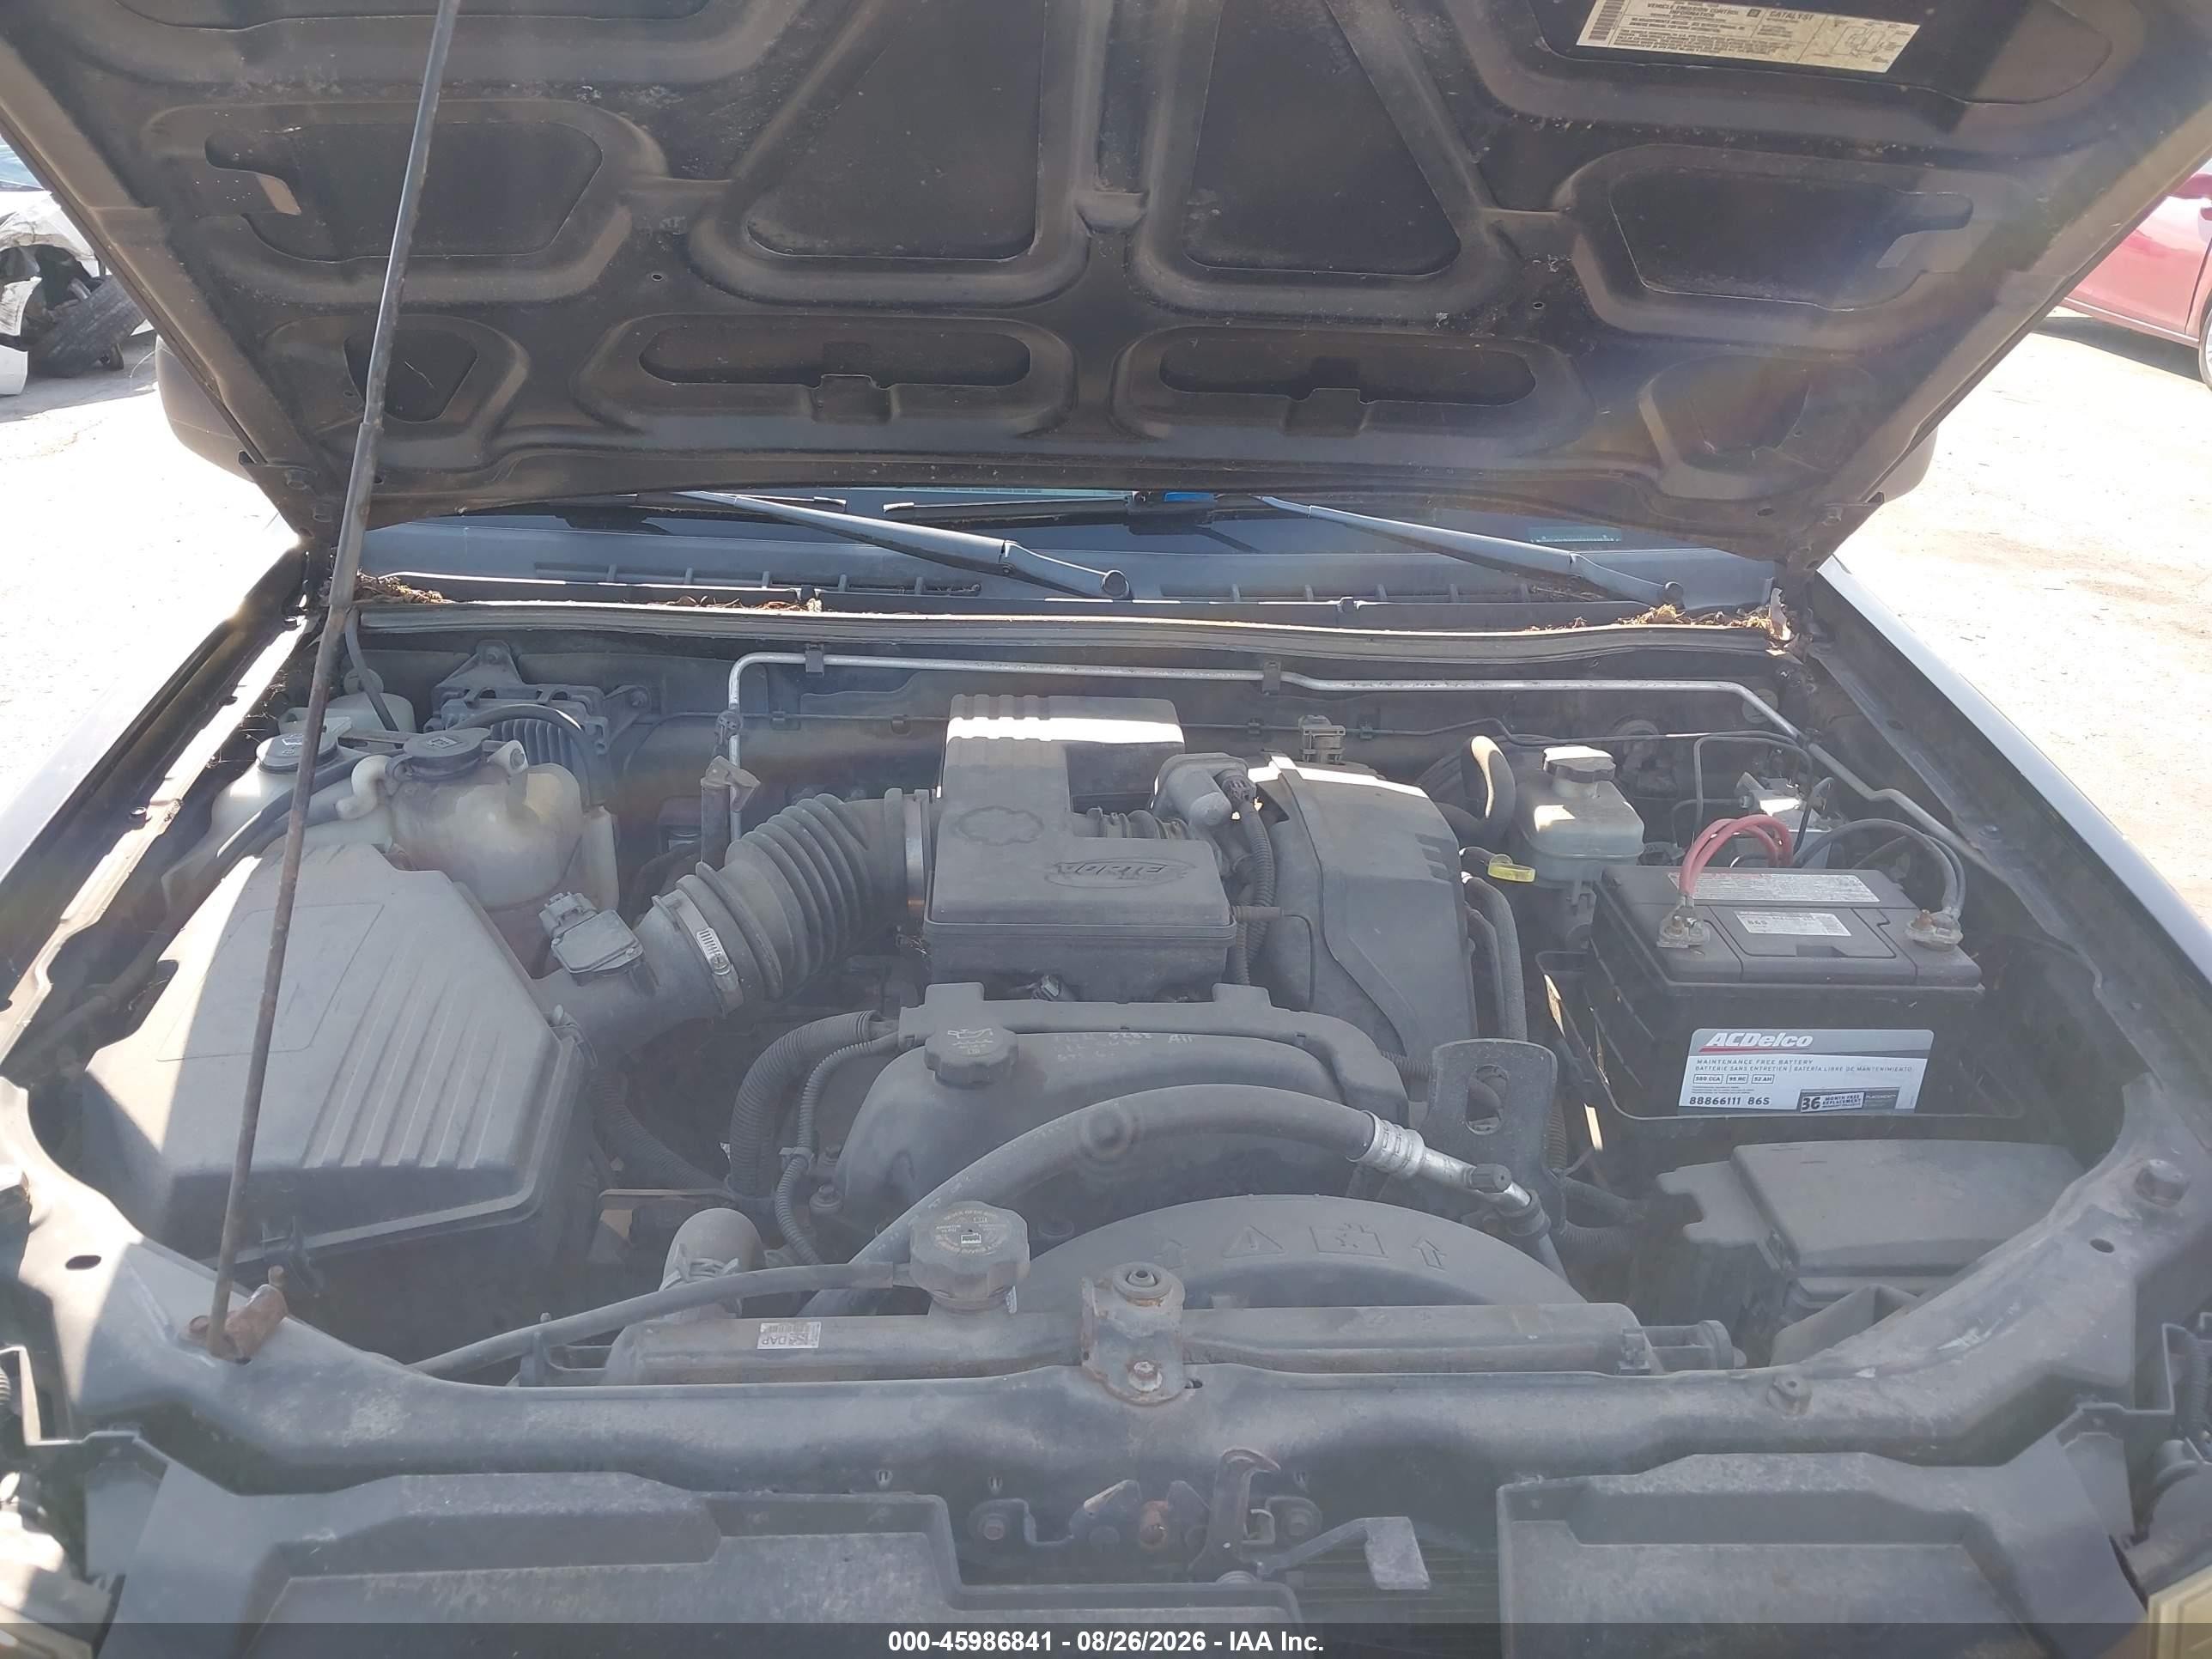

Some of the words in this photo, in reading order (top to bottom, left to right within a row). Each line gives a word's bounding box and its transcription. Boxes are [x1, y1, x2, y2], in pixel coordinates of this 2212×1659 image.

[1769, 10, 1814, 21] CATALYST
[1705, 1032, 1814, 1047] ACDelco
[1689, 1097, 1741, 1105] 88866111
[1802, 1097, 1821, 1110] 36
